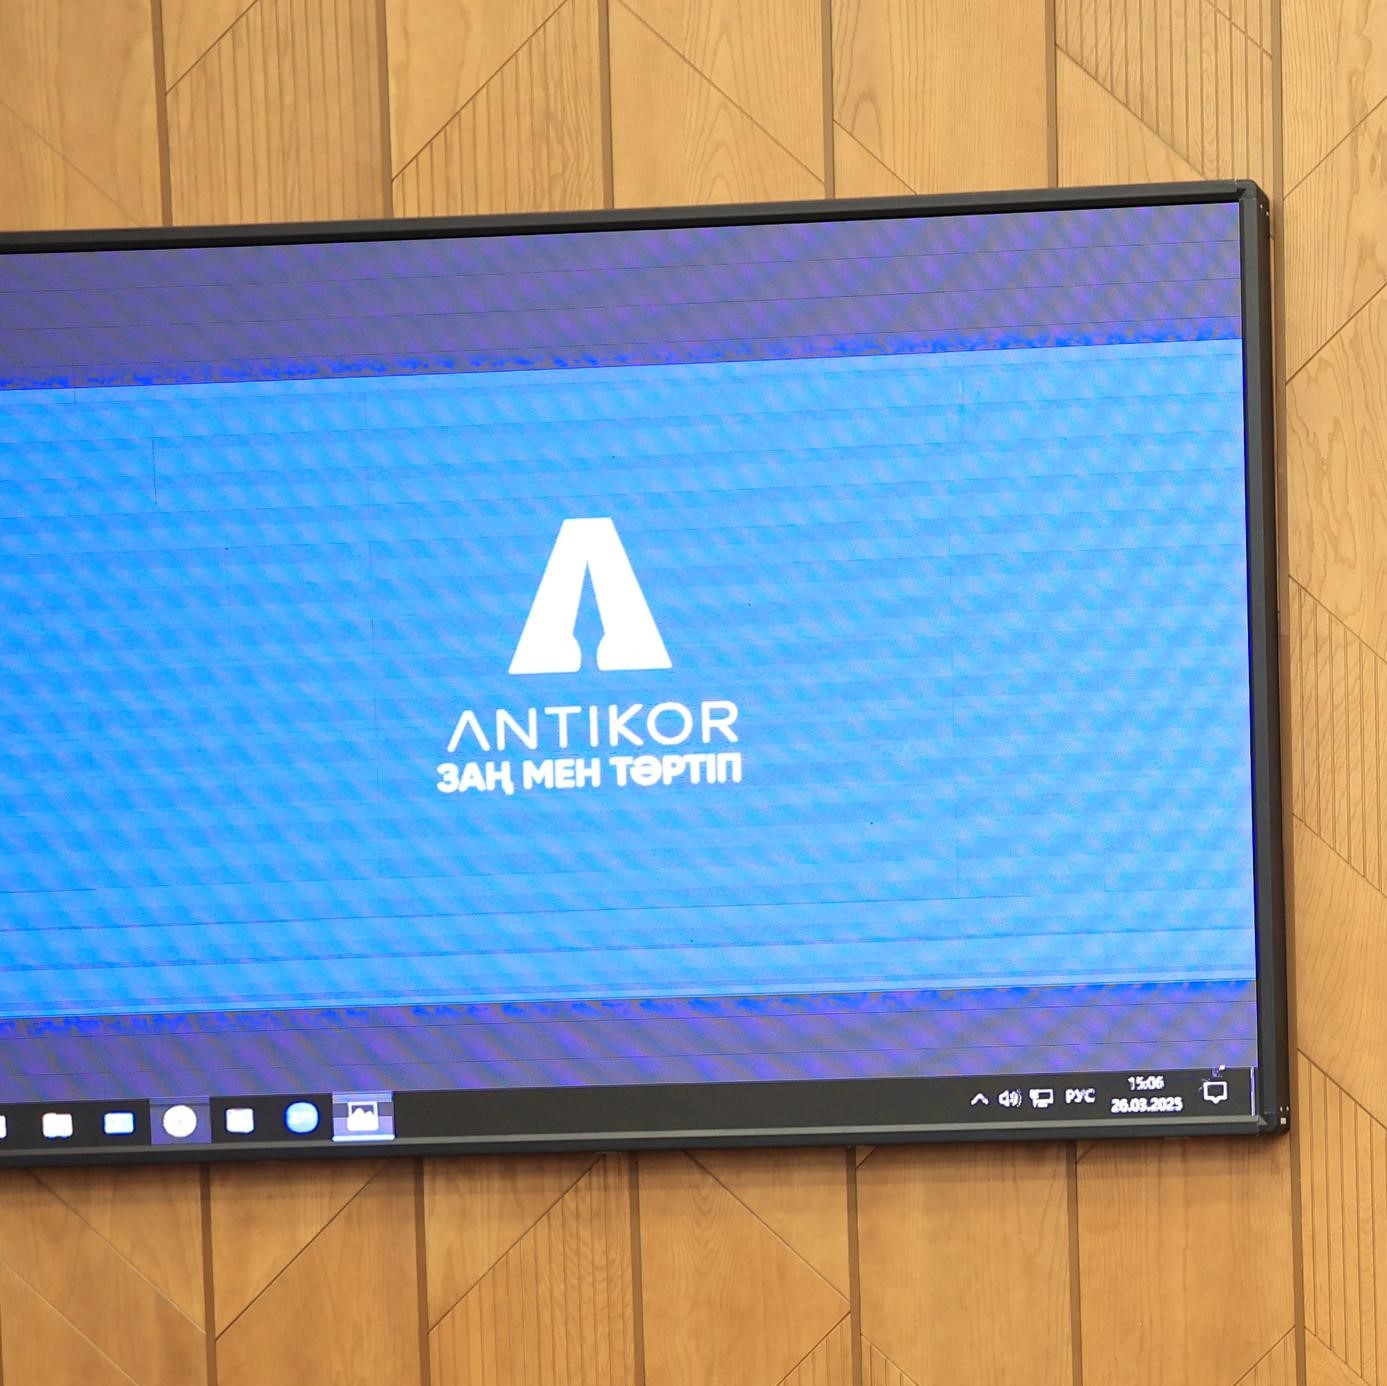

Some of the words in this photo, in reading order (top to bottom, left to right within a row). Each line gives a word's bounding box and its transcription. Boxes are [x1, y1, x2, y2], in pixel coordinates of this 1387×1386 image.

[447, 700, 738, 752] ANTIKOR
[436, 760, 514, 795] ЗАҢ
[523, 758, 600, 790] МЕН
[1065, 1088, 1096, 1103] РУС
